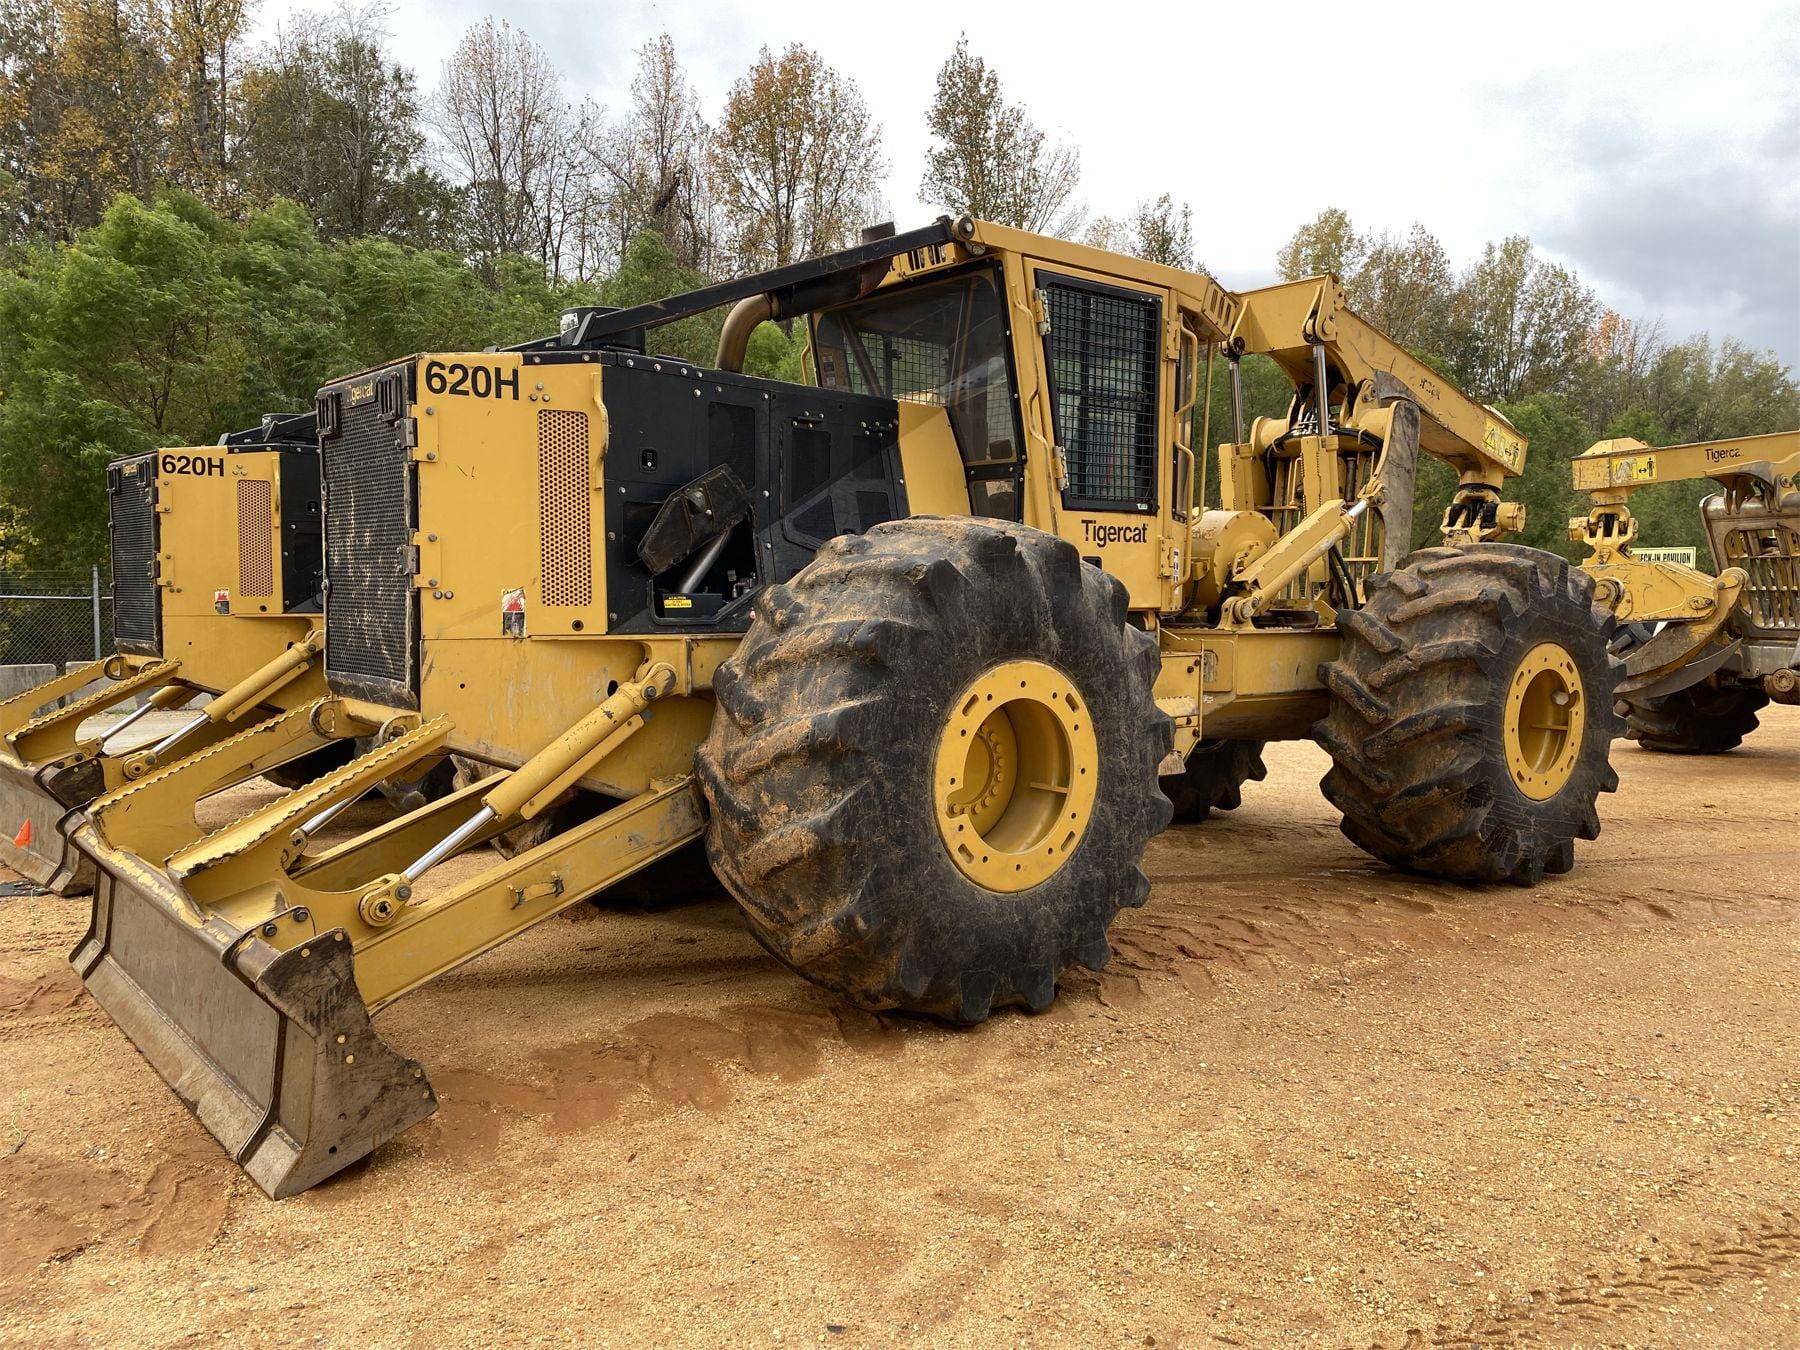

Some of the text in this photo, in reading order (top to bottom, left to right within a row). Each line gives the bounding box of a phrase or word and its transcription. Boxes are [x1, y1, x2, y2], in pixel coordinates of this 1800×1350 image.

[425, 361, 519, 400] 620H
[162, 455, 224, 477] 620H
[1704, 448, 1744, 463] Tigerca
[1081, 520, 1148, 548] Tigercat
[1640, 552, 1691, 564] ECK-IN PAVILION
